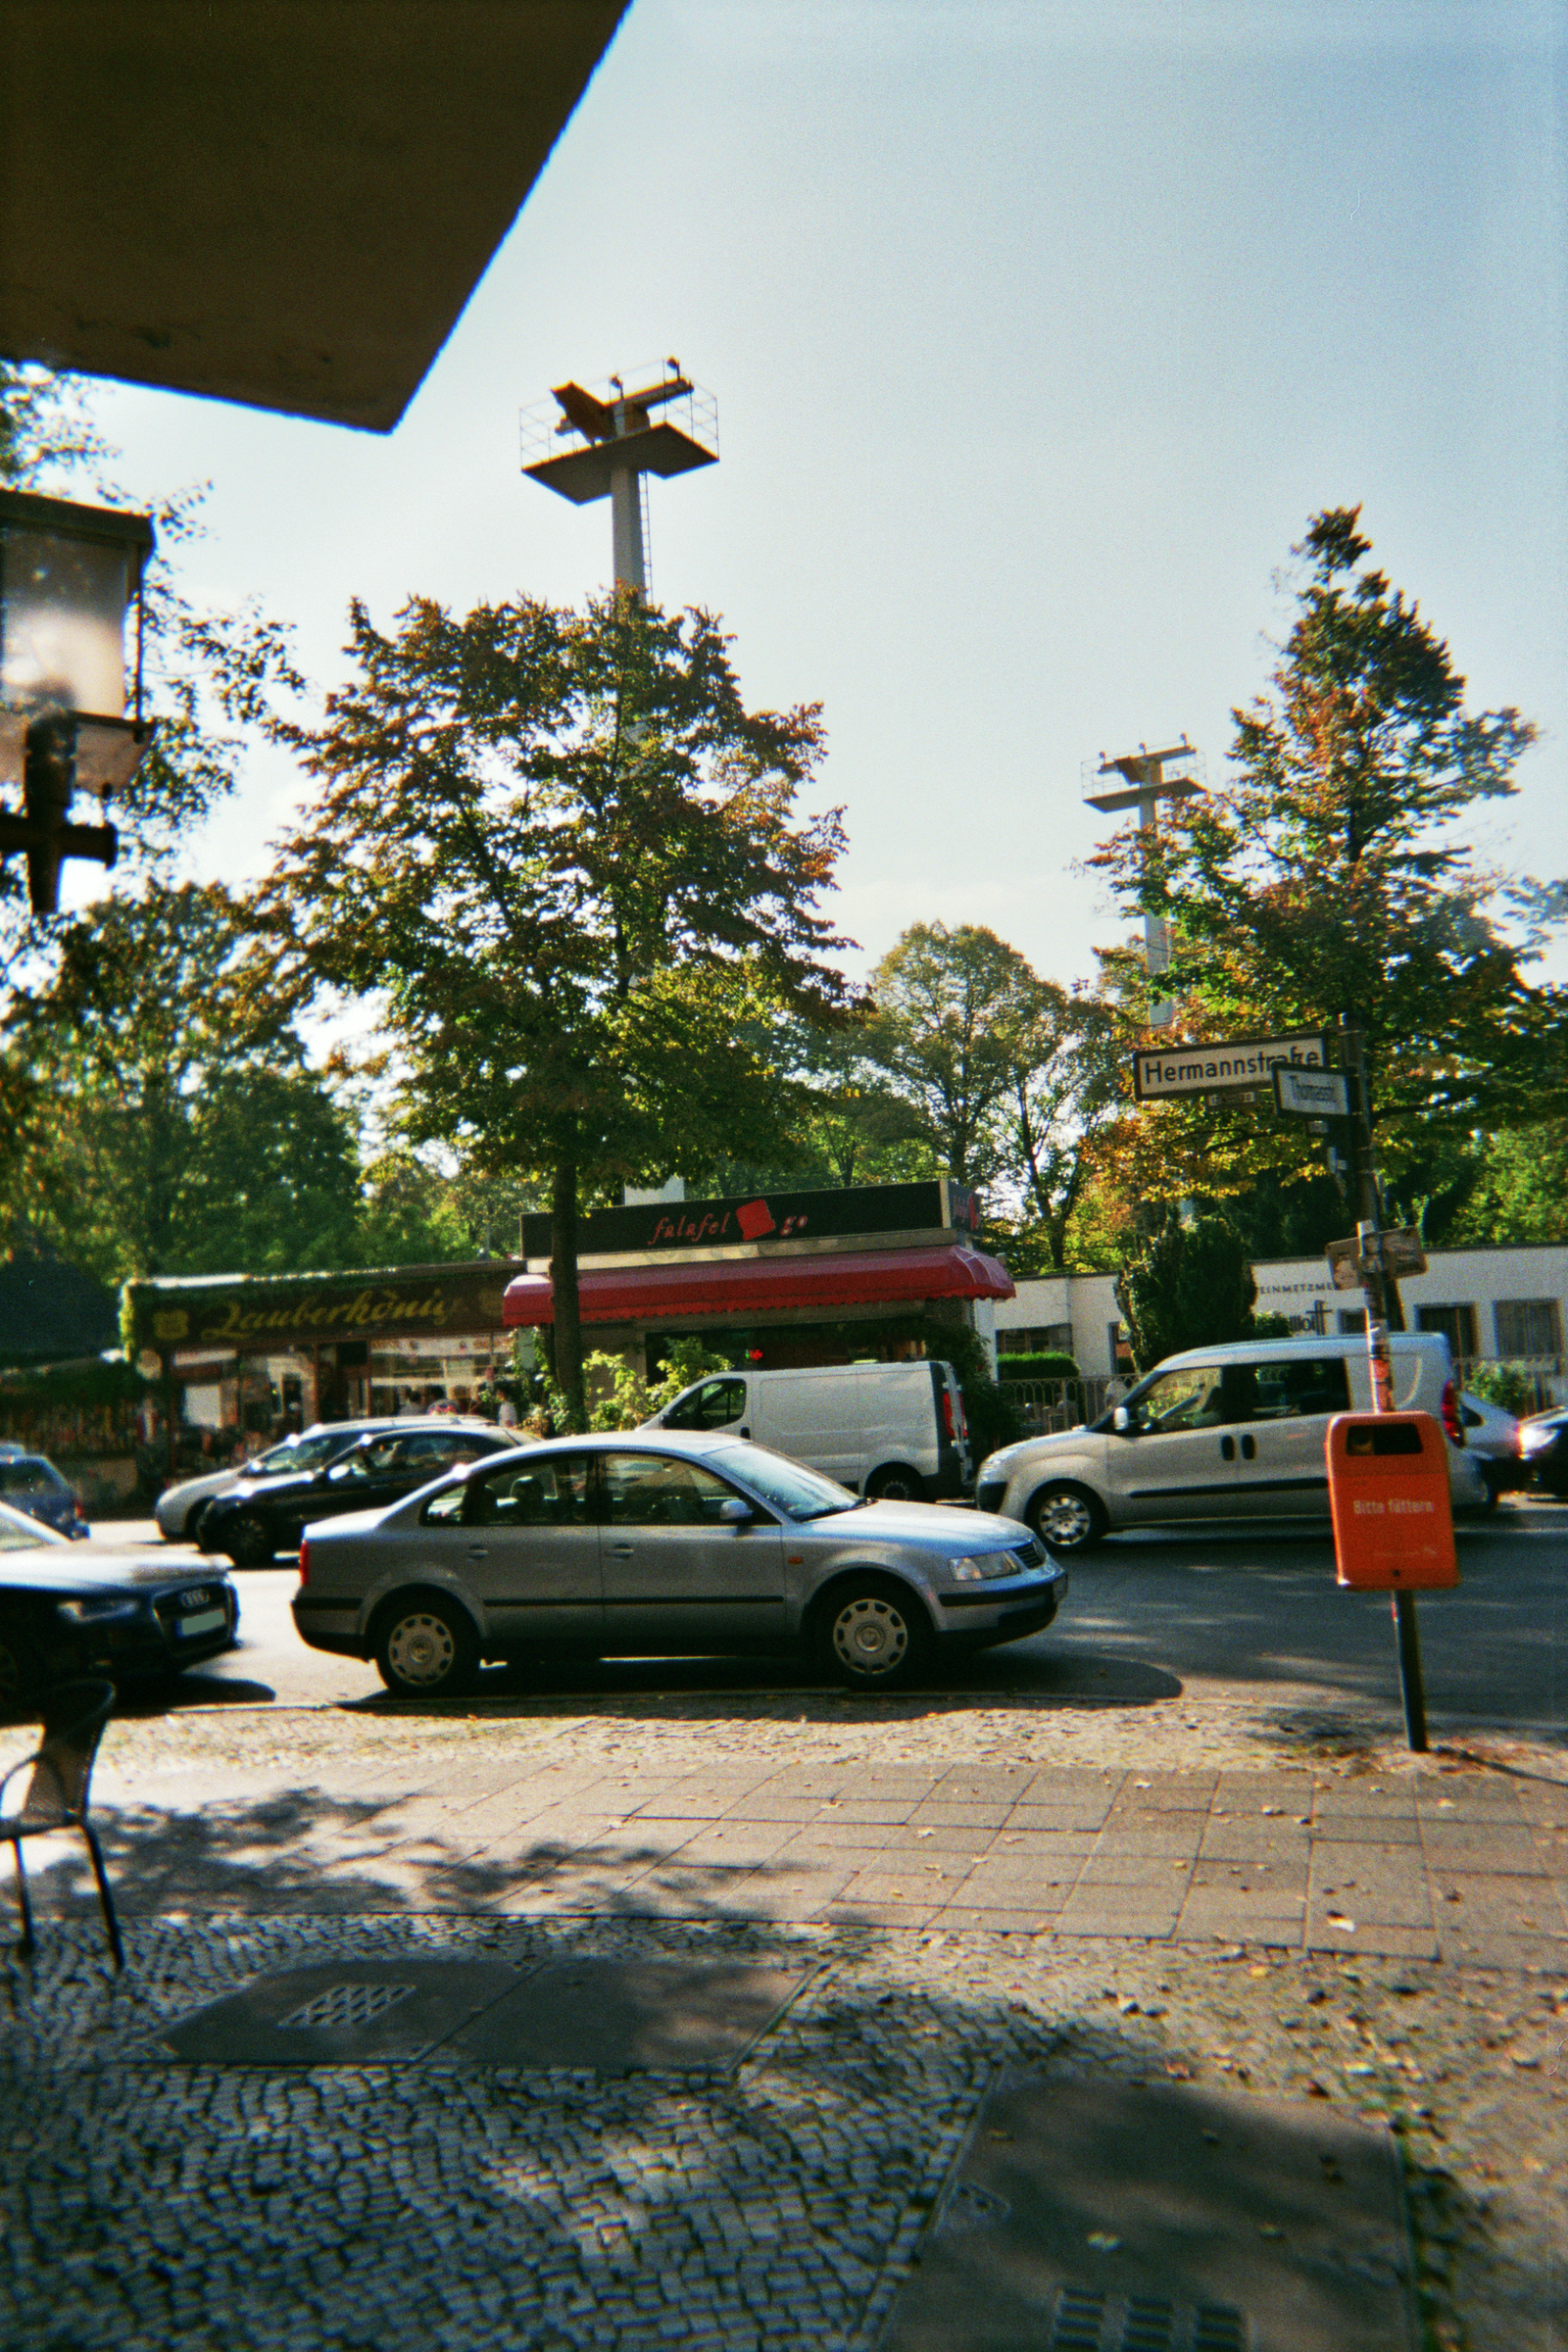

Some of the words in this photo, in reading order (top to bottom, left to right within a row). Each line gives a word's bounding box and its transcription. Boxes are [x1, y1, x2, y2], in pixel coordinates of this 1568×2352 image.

[647, 1211, 730, 1246] falafel
[780, 1215, 808, 1237] go
[1258, 1281, 1333, 1295] EINMETZME
[1352, 1499, 1385, 1515] Bitte
[1388, 1497, 1435, 1514] füttern
